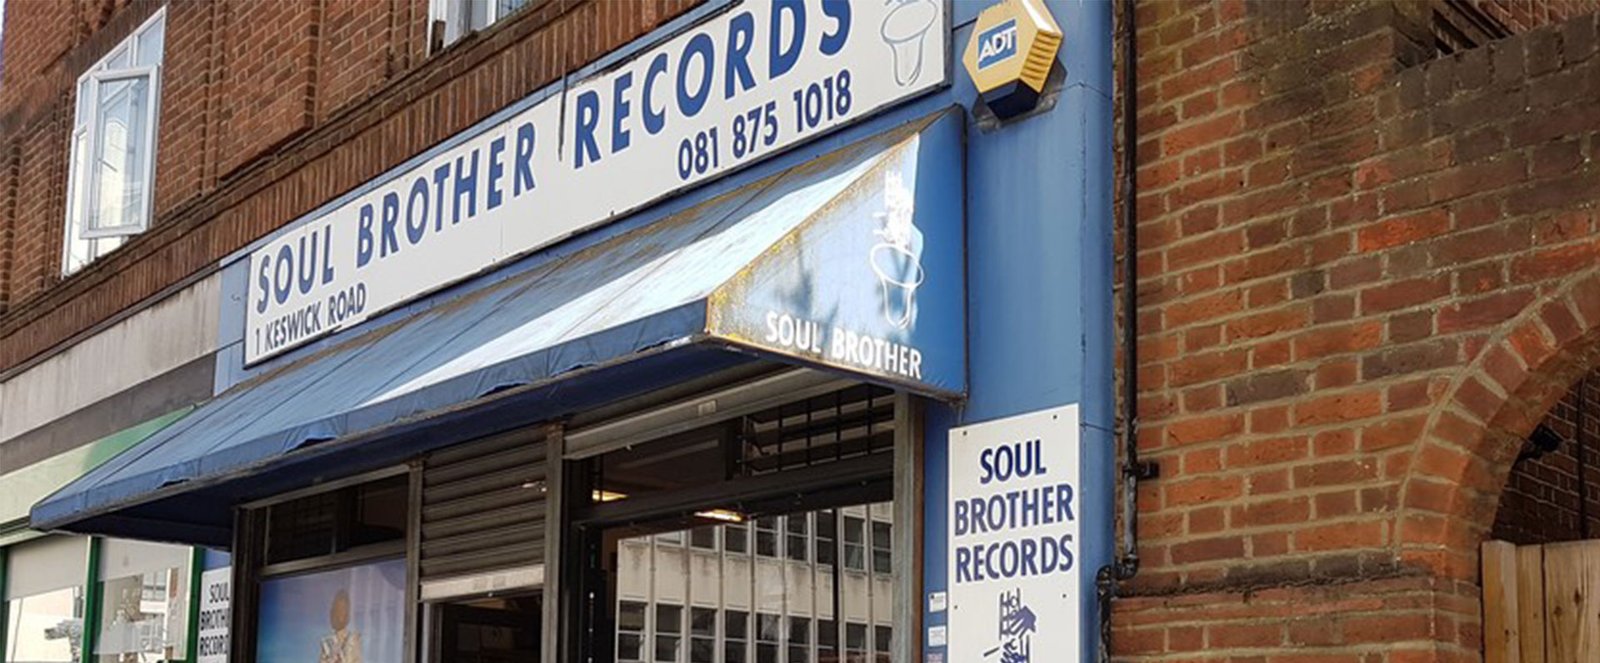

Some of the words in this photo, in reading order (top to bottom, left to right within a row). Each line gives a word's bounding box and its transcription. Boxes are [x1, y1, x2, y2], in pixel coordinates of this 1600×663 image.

[979, 26, 1016, 62] ADT
[678, 127, 718, 180] 081
[732, 101, 778, 159] 875
[794, 69, 852, 132] 1018
[258, 225, 334, 314] SOUL
[357, 122, 536, 268] BROTHER
[574, 0, 852, 169] RECORDS
[265, 301, 322, 350] KESWICK
[328, 282, 366, 326] ROAD
[765, 311, 822, 353] SOUL
[831, 328, 922, 379] BROTHER
[980, 439, 1046, 485] SOUL
[954, 483, 1075, 536] BROTHER
[956, 534, 1074, 583] RECORDS
[209, 582, 229, 603] SOUL
